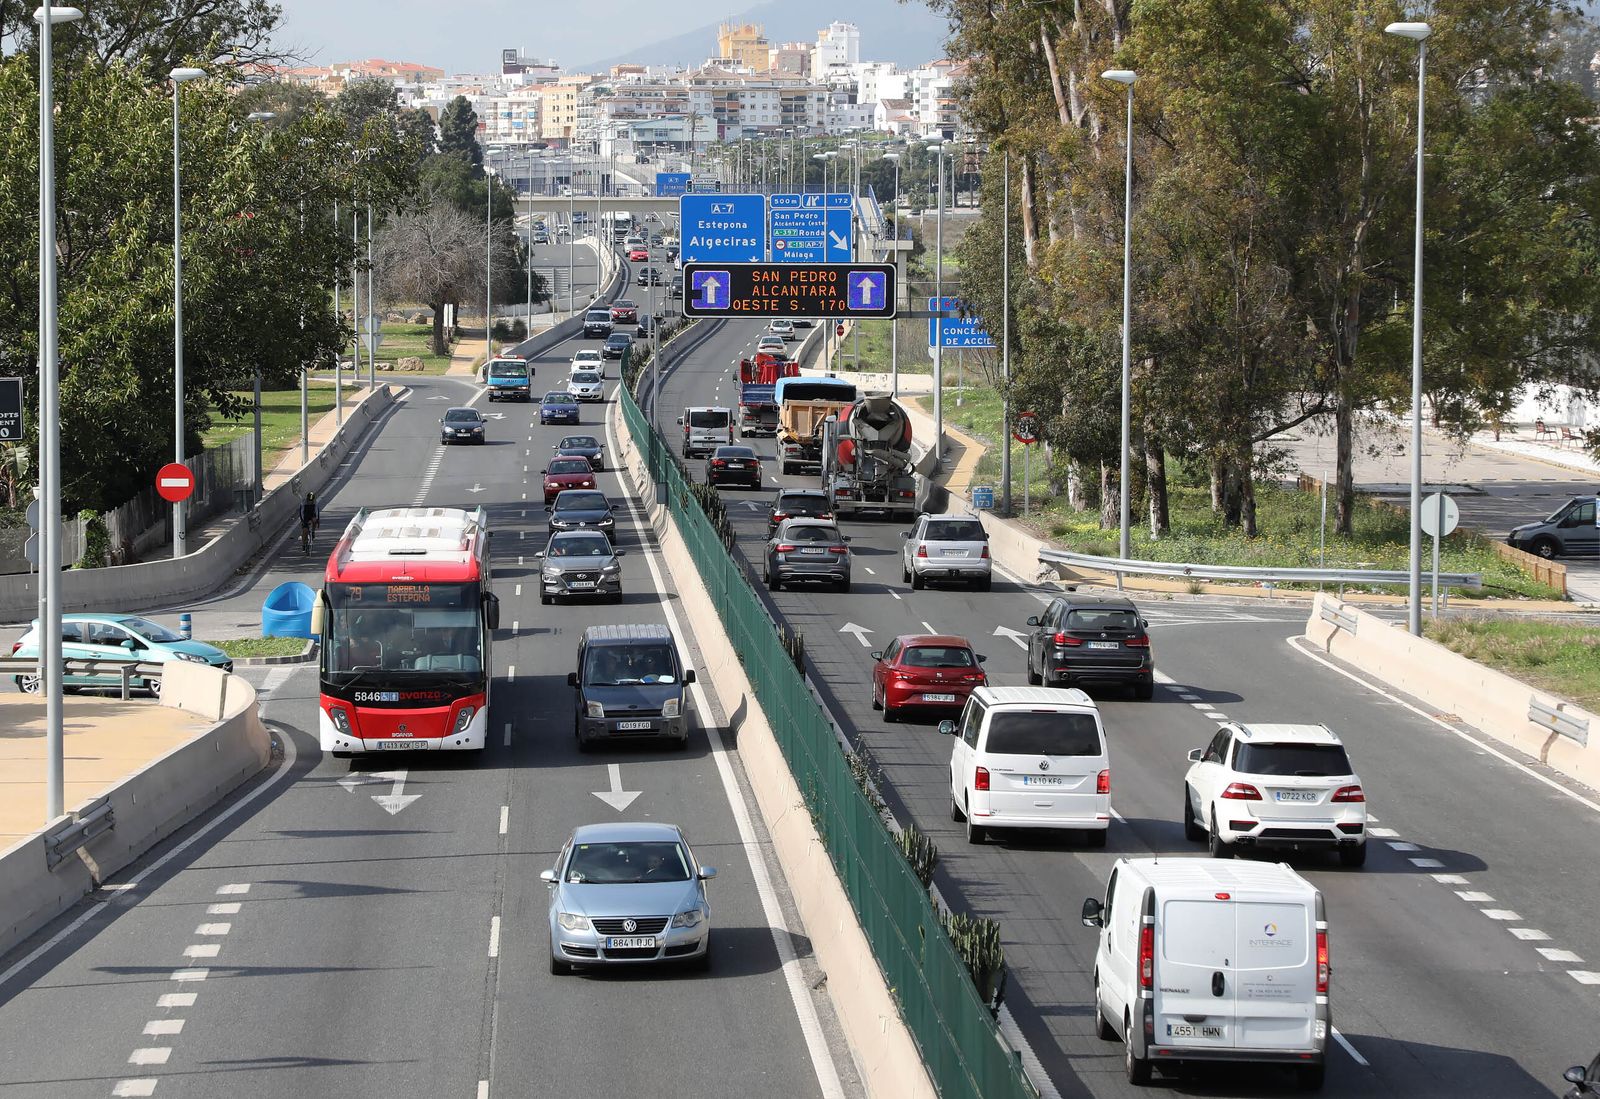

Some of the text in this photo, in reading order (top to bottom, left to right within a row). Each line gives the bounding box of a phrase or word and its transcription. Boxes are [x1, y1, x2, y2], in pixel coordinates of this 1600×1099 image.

[713, 204, 733, 213] A-7
[698, 220, 748, 230] Estepona
[689, 235, 757, 250] Algeciras
[784, 251, 814, 259] Málaga
[752, 271, 837, 282] SAN PEDRO
[752, 285, 837, 297] ALCANTARA
[732, 299, 846, 311] OESTE S. 170
[349, 585, 430, 602] 79 MARBELLA
[387, 593, 431, 603] ESTEPONA
[354, 691, 441, 701] 5846 avanza
[1281, 792, 1300, 800] 0722
[1174, 1026, 1220, 1037] 4551 HMN
